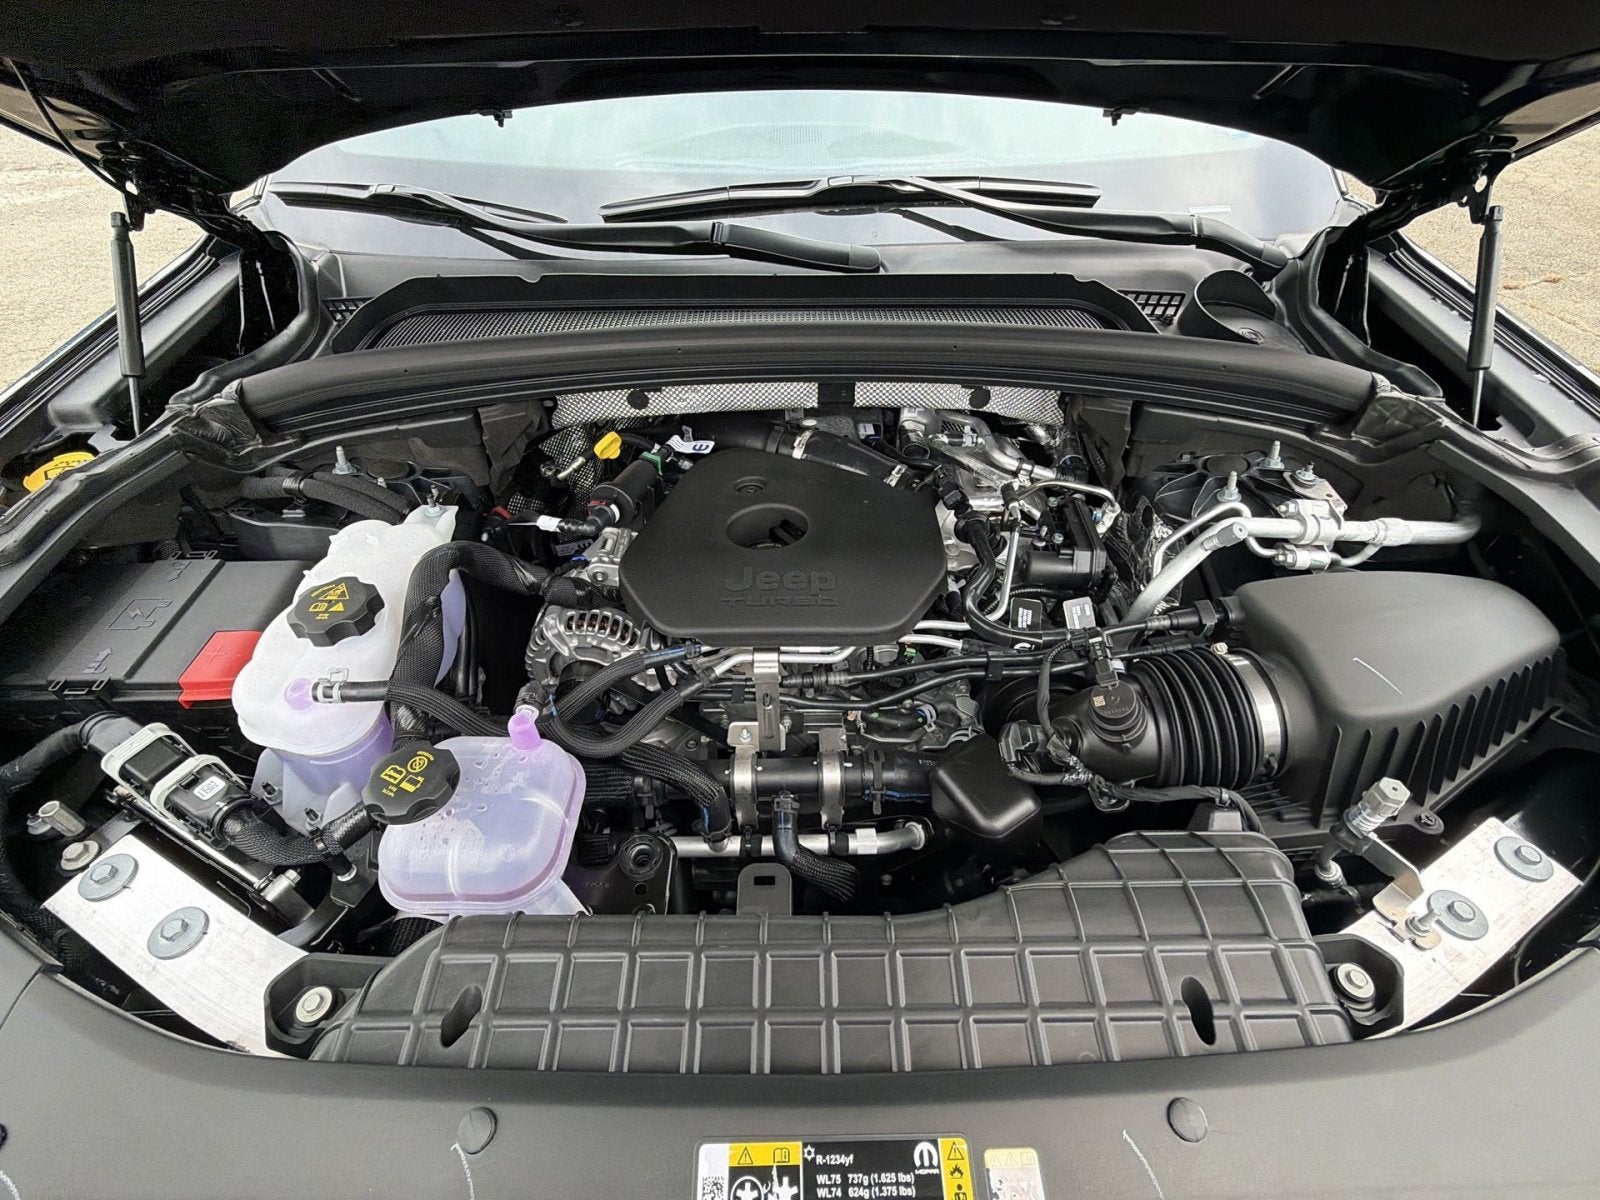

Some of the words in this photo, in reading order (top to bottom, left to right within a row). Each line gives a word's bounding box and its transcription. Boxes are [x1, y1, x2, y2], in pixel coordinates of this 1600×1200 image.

[724, 566, 837, 596] Jeep
[721, 597, 839, 607] TURBO
[816, 1154, 854, 1166] R-1234yf
[816, 1174, 841, 1184] WL75
[848, 1173, 868, 1186] 737g
[870, 1172, 896, 1186] (1.625
[898, 1172, 915, 1184] lbs)
[817, 1187, 842, 1198] WL74
[848, 1186, 869, 1199] 624g
[871, 1186, 898, 1198] (1.375
[899, 1185, 916, 1197] lbs)
